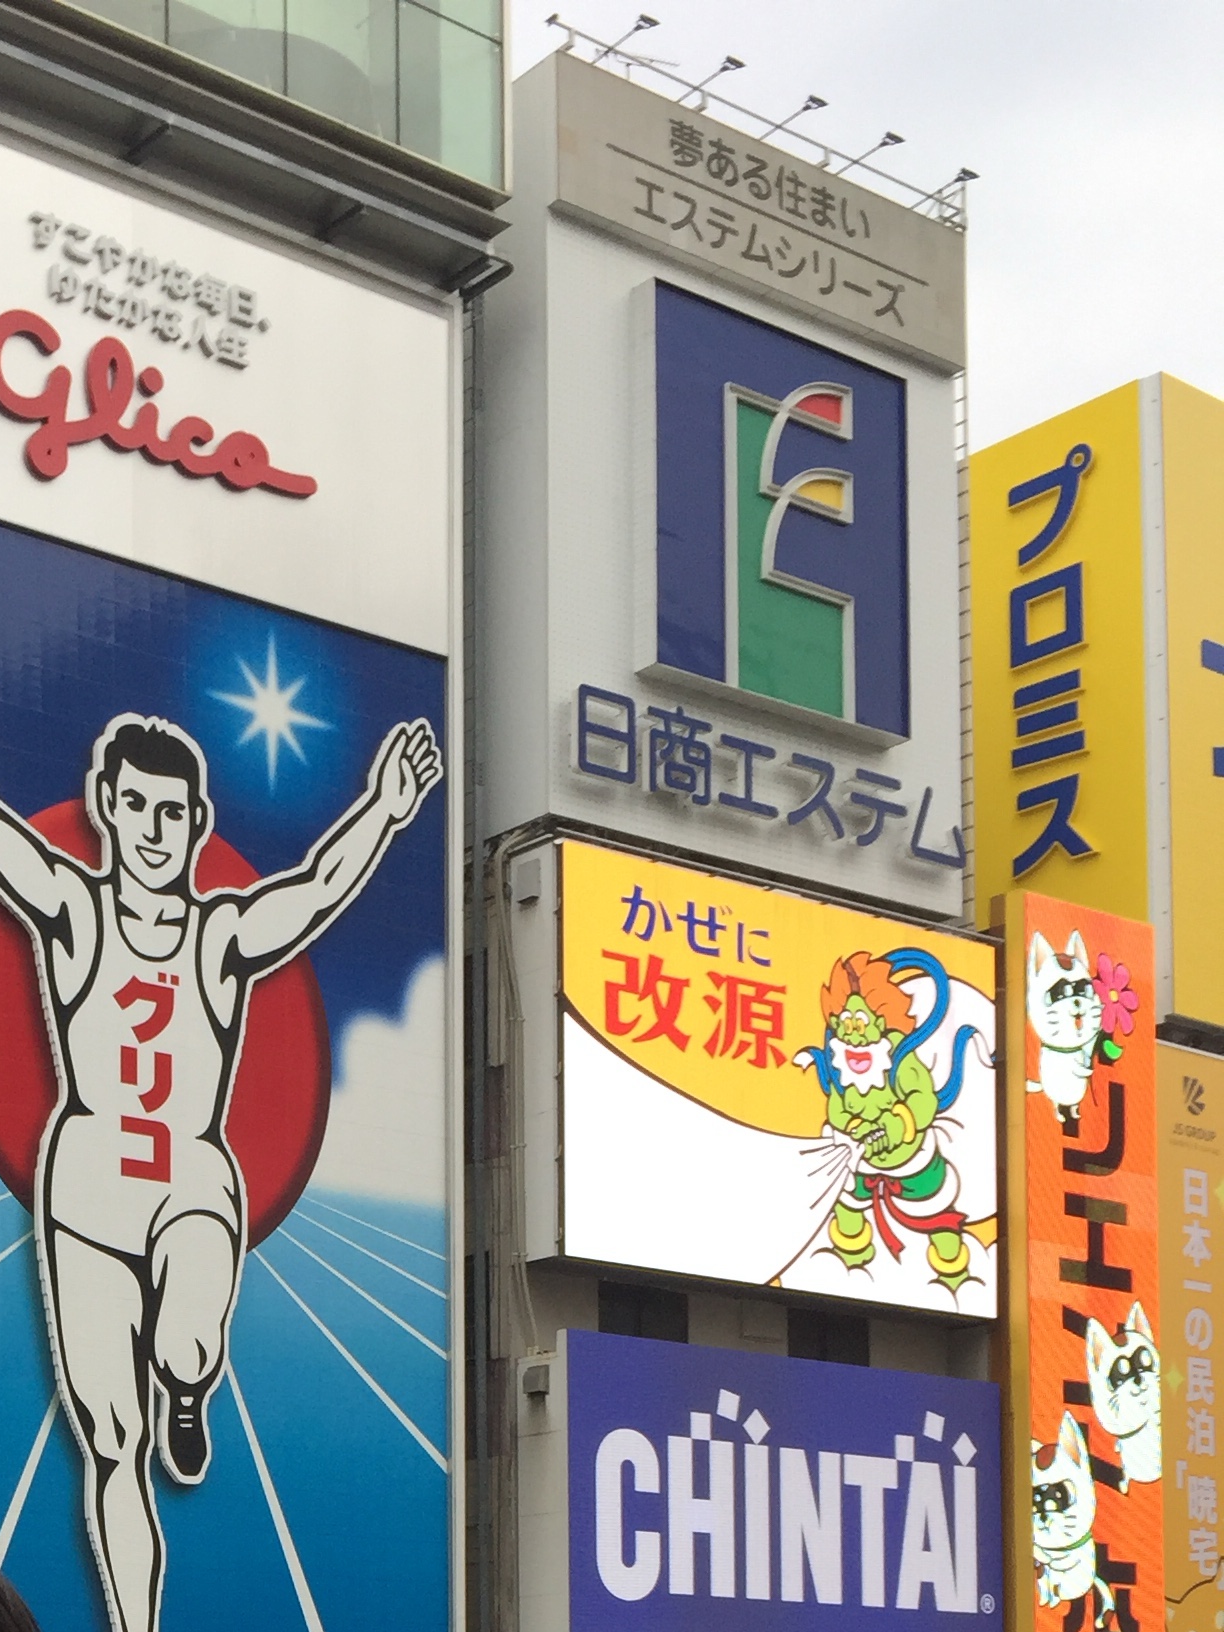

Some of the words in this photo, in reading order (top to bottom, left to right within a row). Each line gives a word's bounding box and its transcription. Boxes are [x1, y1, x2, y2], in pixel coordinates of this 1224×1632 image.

[668, 118, 871, 240] 夢ある住まい
[27, 210, 272, 334] すこやかな毎日、
[634, 177, 906, 327] エステムシリーズ
[47, 264, 250, 371] ゆたかな人生
[1008, 443, 1100, 880] プロミス
[577, 683, 968, 868] 日商エステム
[621, 884, 771, 967] かぜに
[602, 949, 788, 1069] 改源
[112, 971, 180, 1184] グリコ
